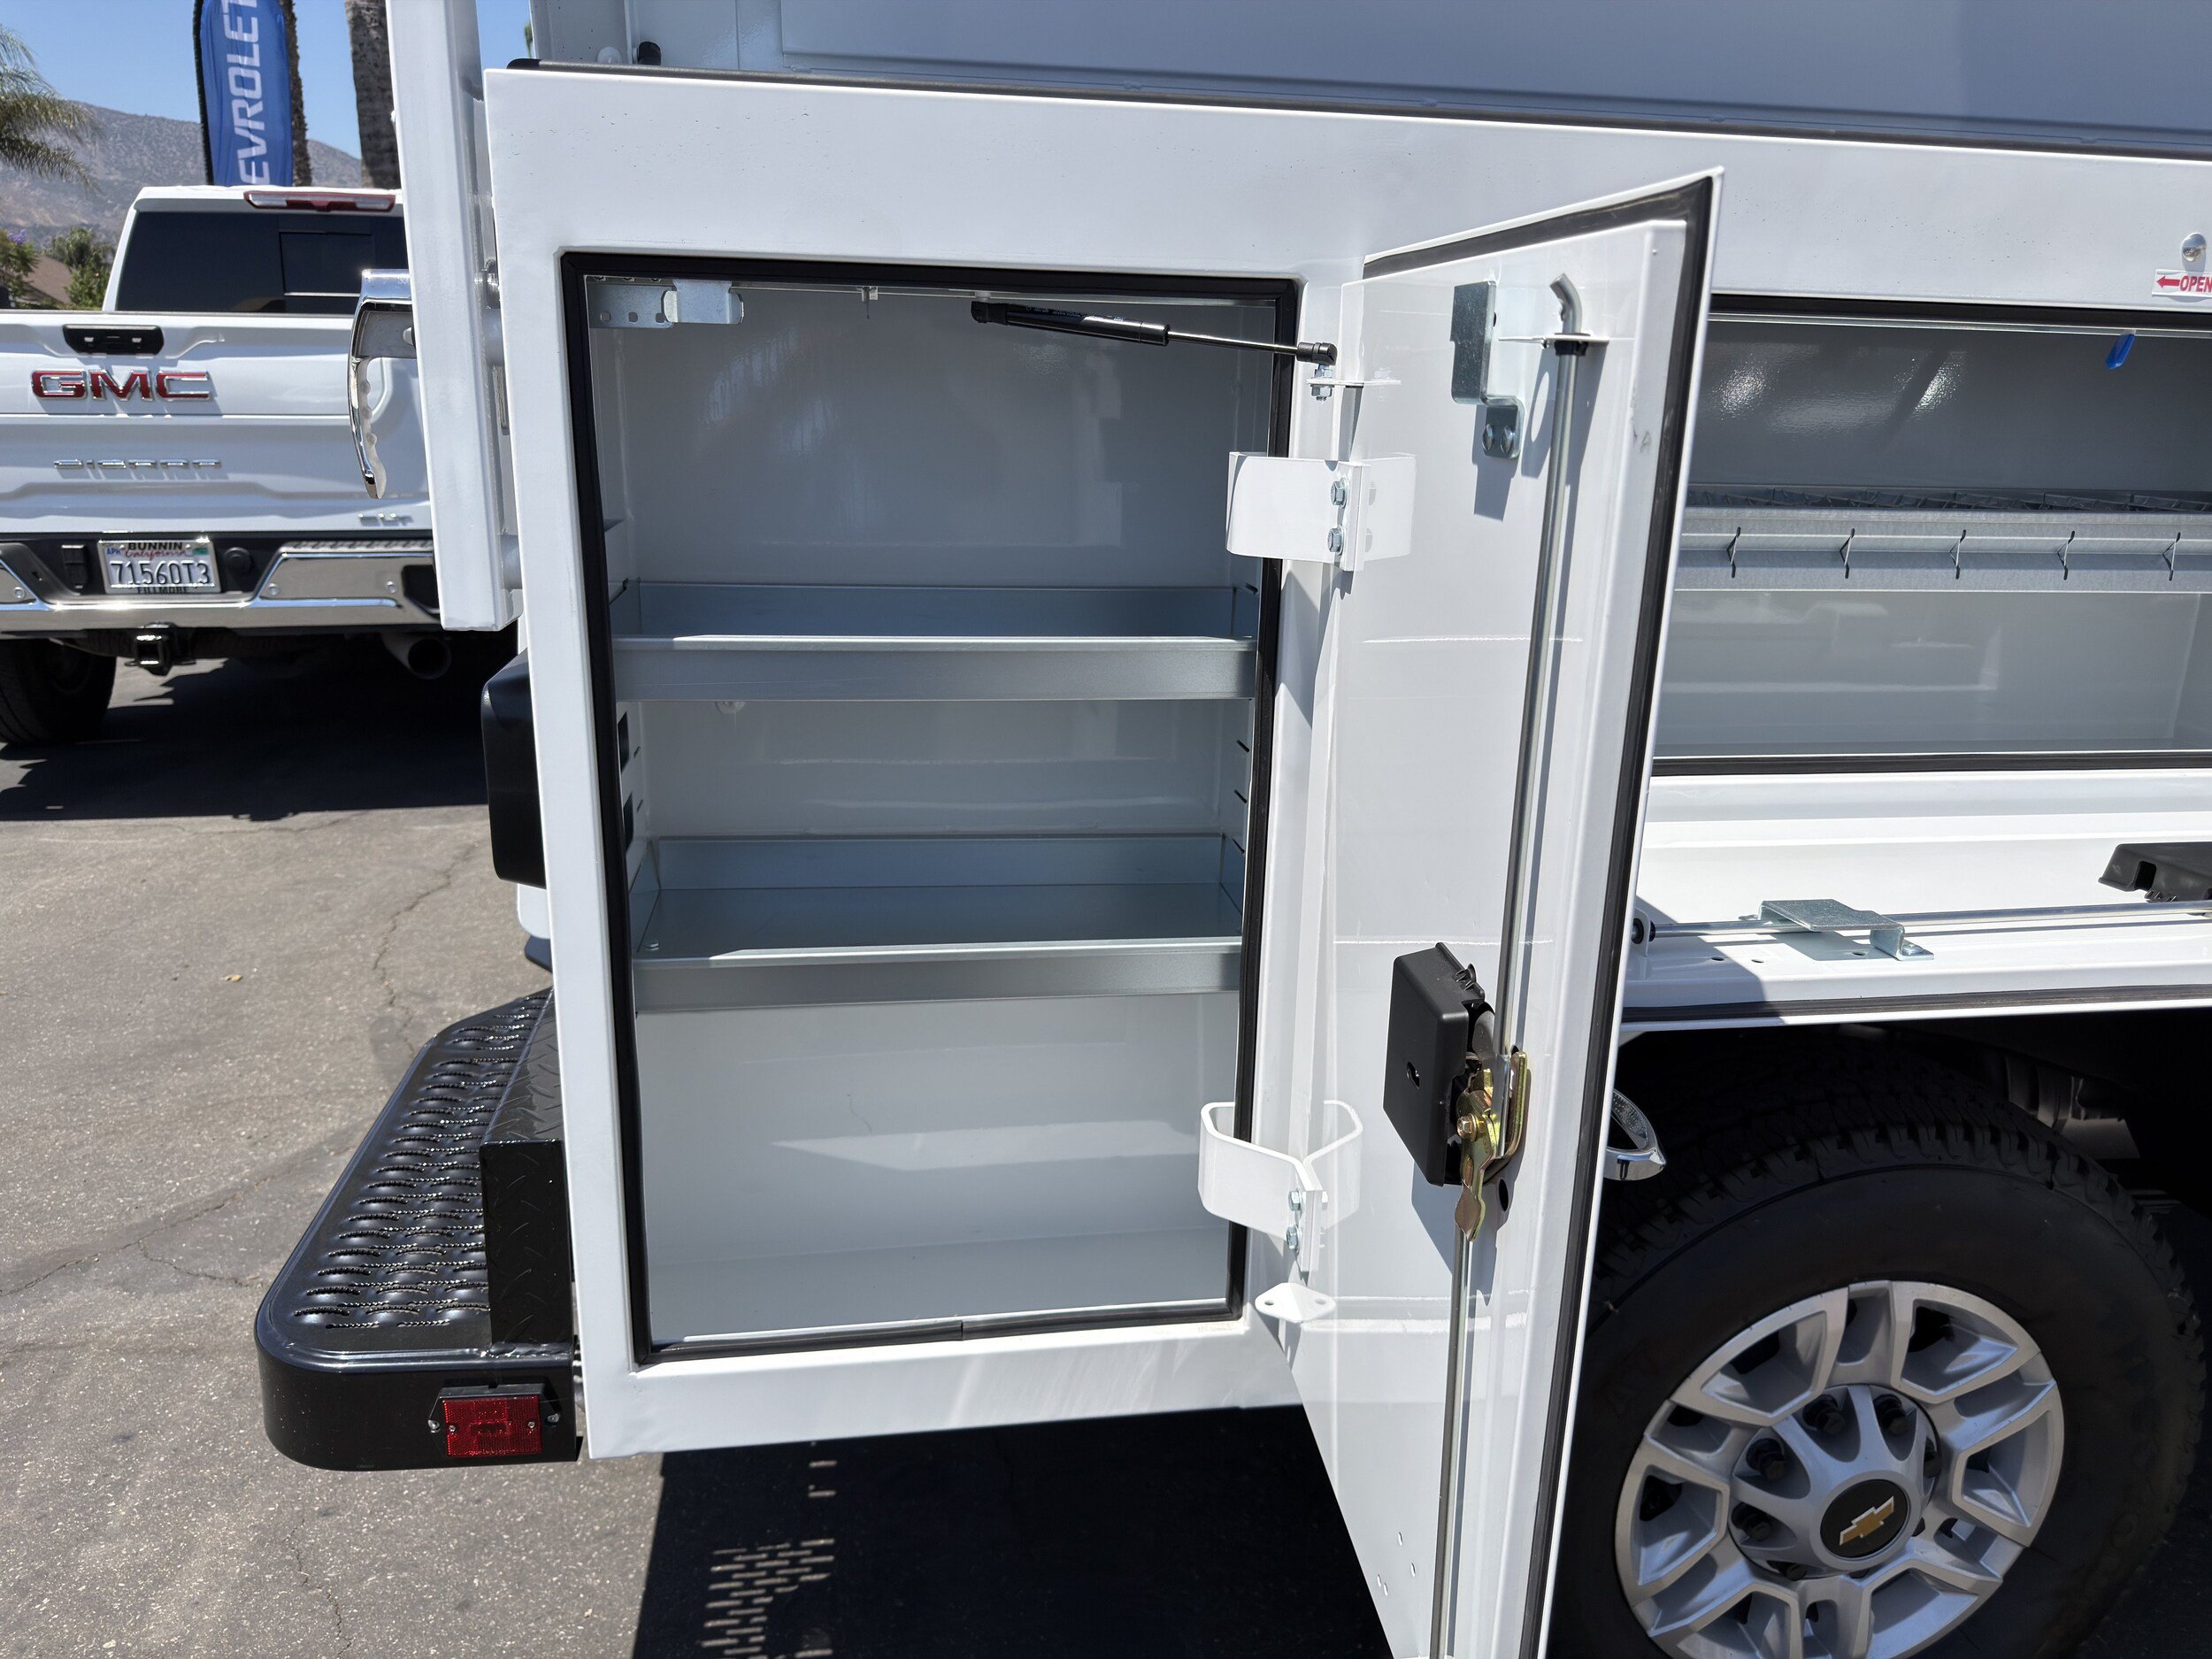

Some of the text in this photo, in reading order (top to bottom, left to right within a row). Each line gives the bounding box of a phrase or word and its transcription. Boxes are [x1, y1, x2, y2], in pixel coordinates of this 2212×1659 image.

[2180, 275, 2212, 293] OPEN
[31, 369, 211, 401] GMC
[110, 560, 210, 585] 71560T3
